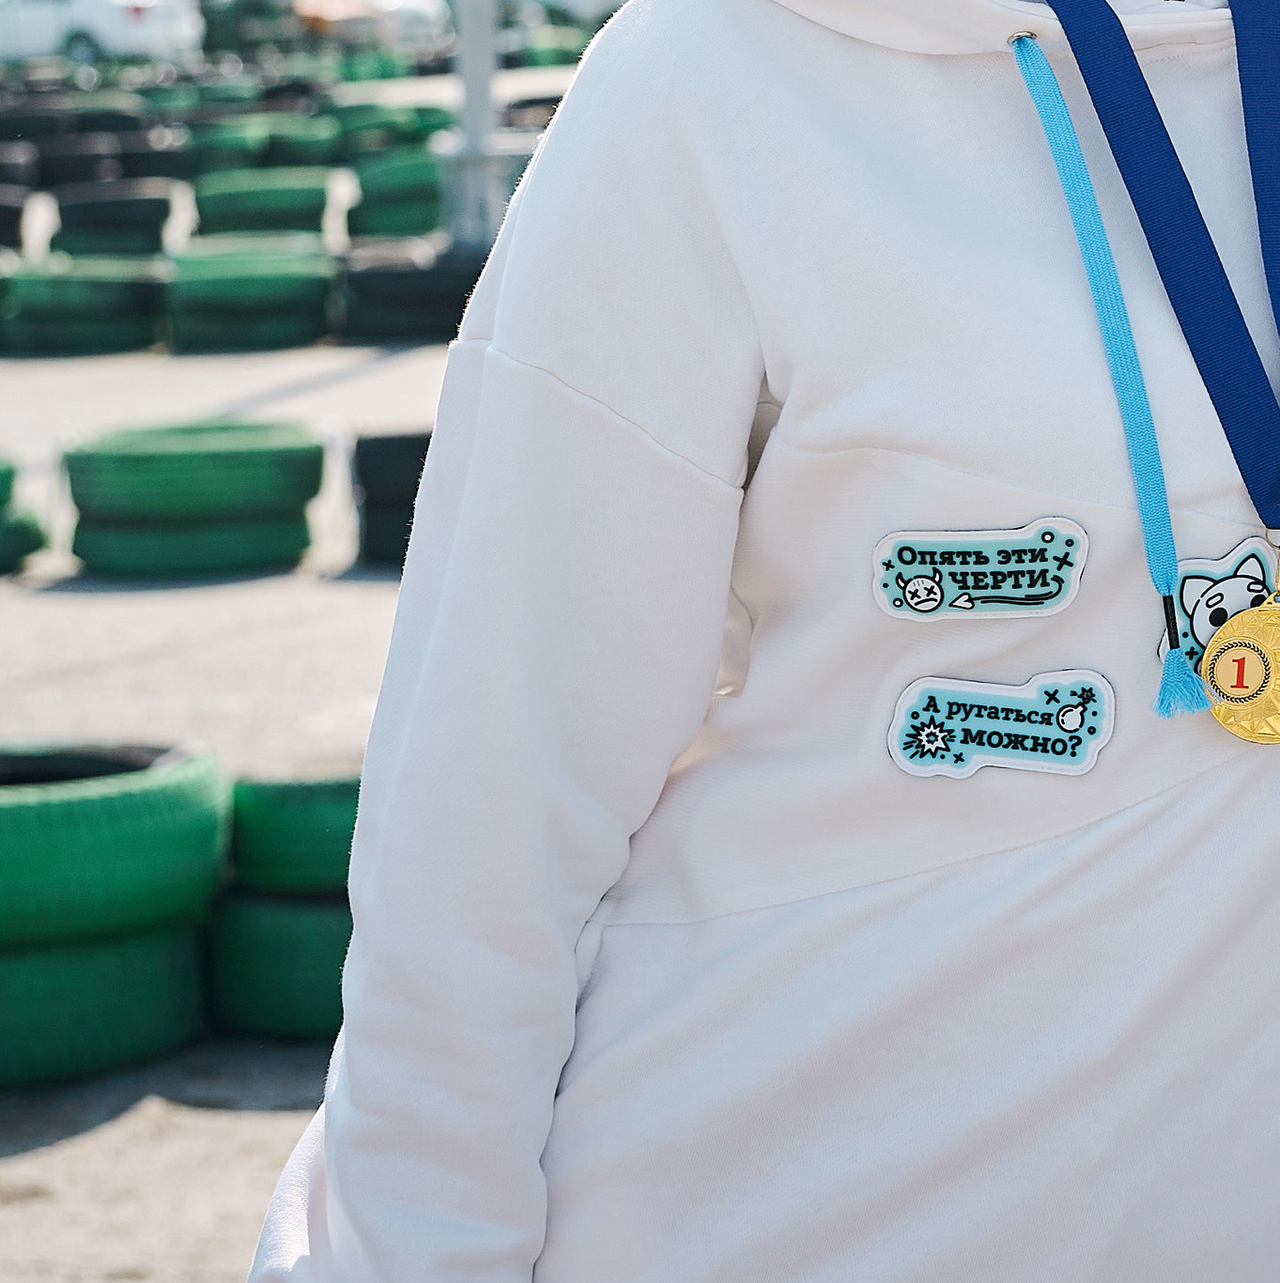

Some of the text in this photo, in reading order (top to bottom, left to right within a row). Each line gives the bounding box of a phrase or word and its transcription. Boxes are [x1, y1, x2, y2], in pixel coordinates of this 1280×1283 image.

[897, 545, 1049, 567] Опять эти
[948, 568, 1051, 591] ЧЕРТИ
[1230, 656, 1250, 689] 1
[921, 694, 1054, 727] А ругаться
